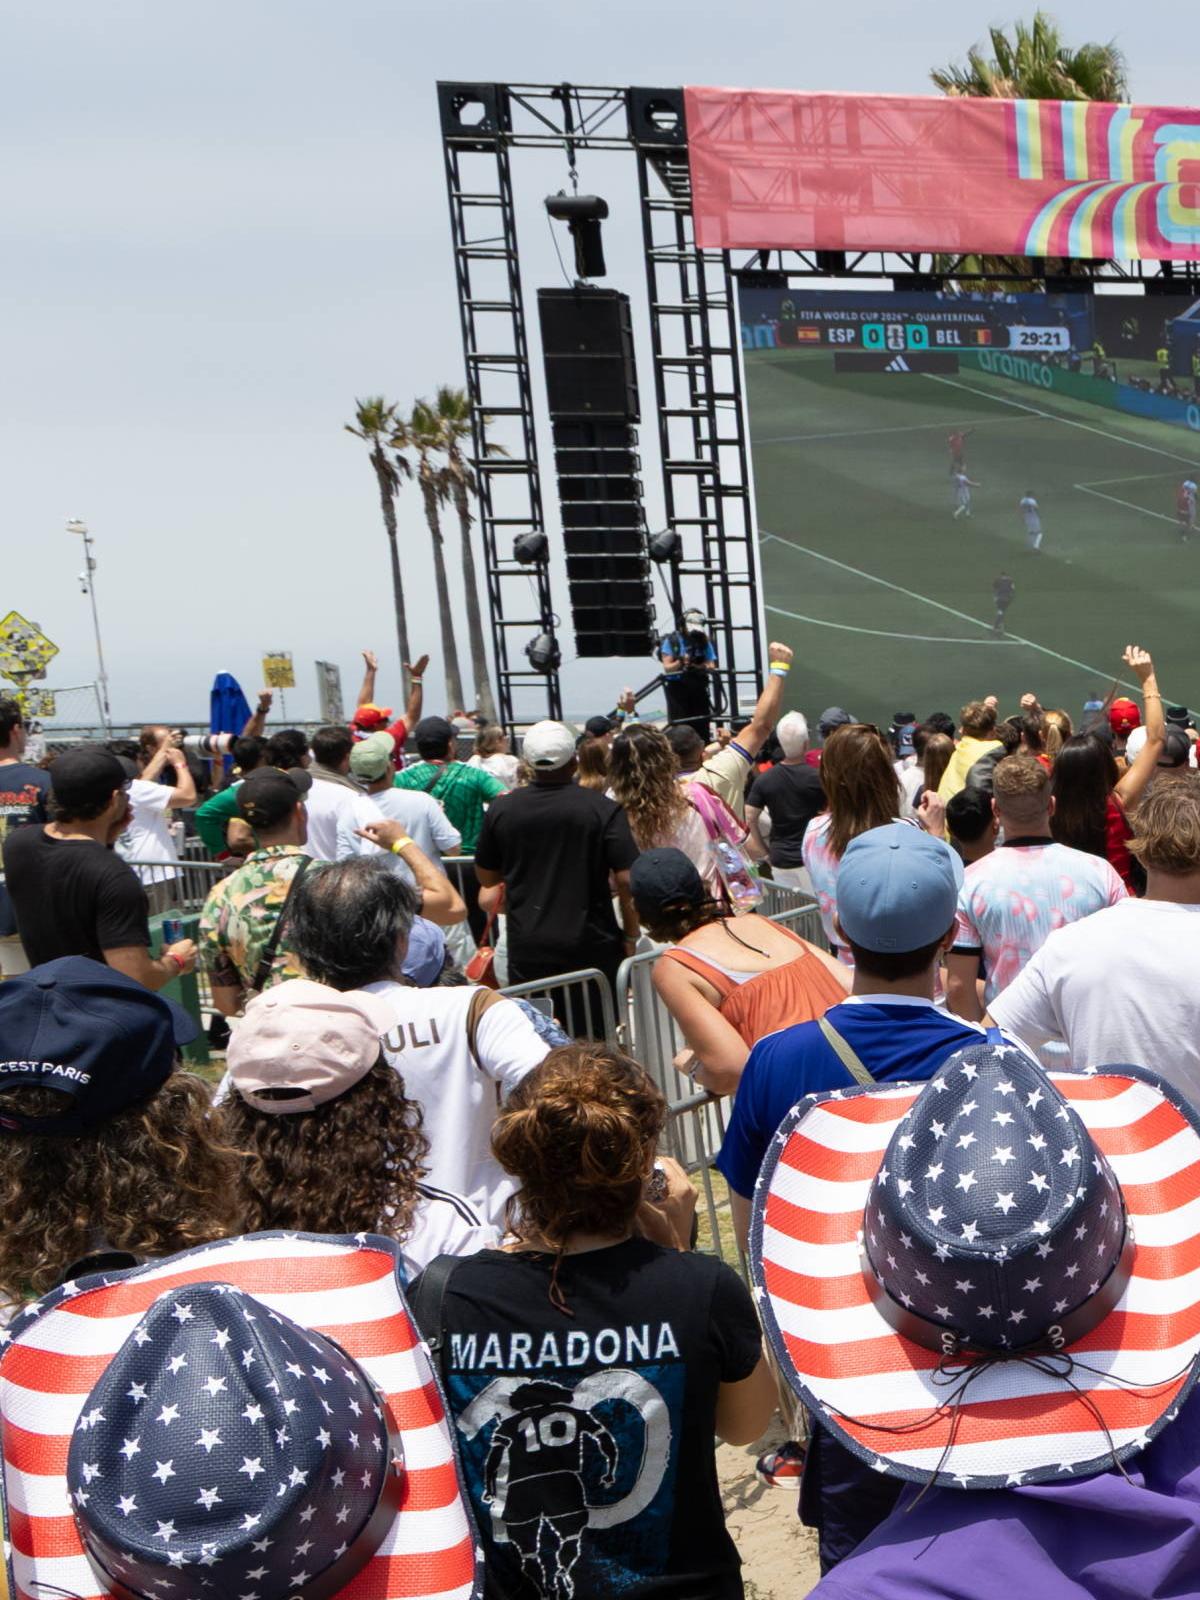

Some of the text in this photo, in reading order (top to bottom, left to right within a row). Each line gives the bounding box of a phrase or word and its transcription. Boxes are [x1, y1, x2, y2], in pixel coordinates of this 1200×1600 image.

[801, 311, 822, 320] FIFA
[823, 311, 858, 321] WORLD
[860, 312, 878, 321] CUP
[917, 312, 986, 323] QUARTERFINAL
[828, 328, 856, 343] ESP
[936, 330, 961, 345] BEL
[1020, 332, 1061, 345] 29:21
[978, 349, 1052, 388] aramco
[383, 1018, 441, 1053] ULI
[0, 1061, 91, 1085] C'EST PARIS
[451, 1322, 681, 1370] MARADONA
[517, 1410, 578, 1453] 10
